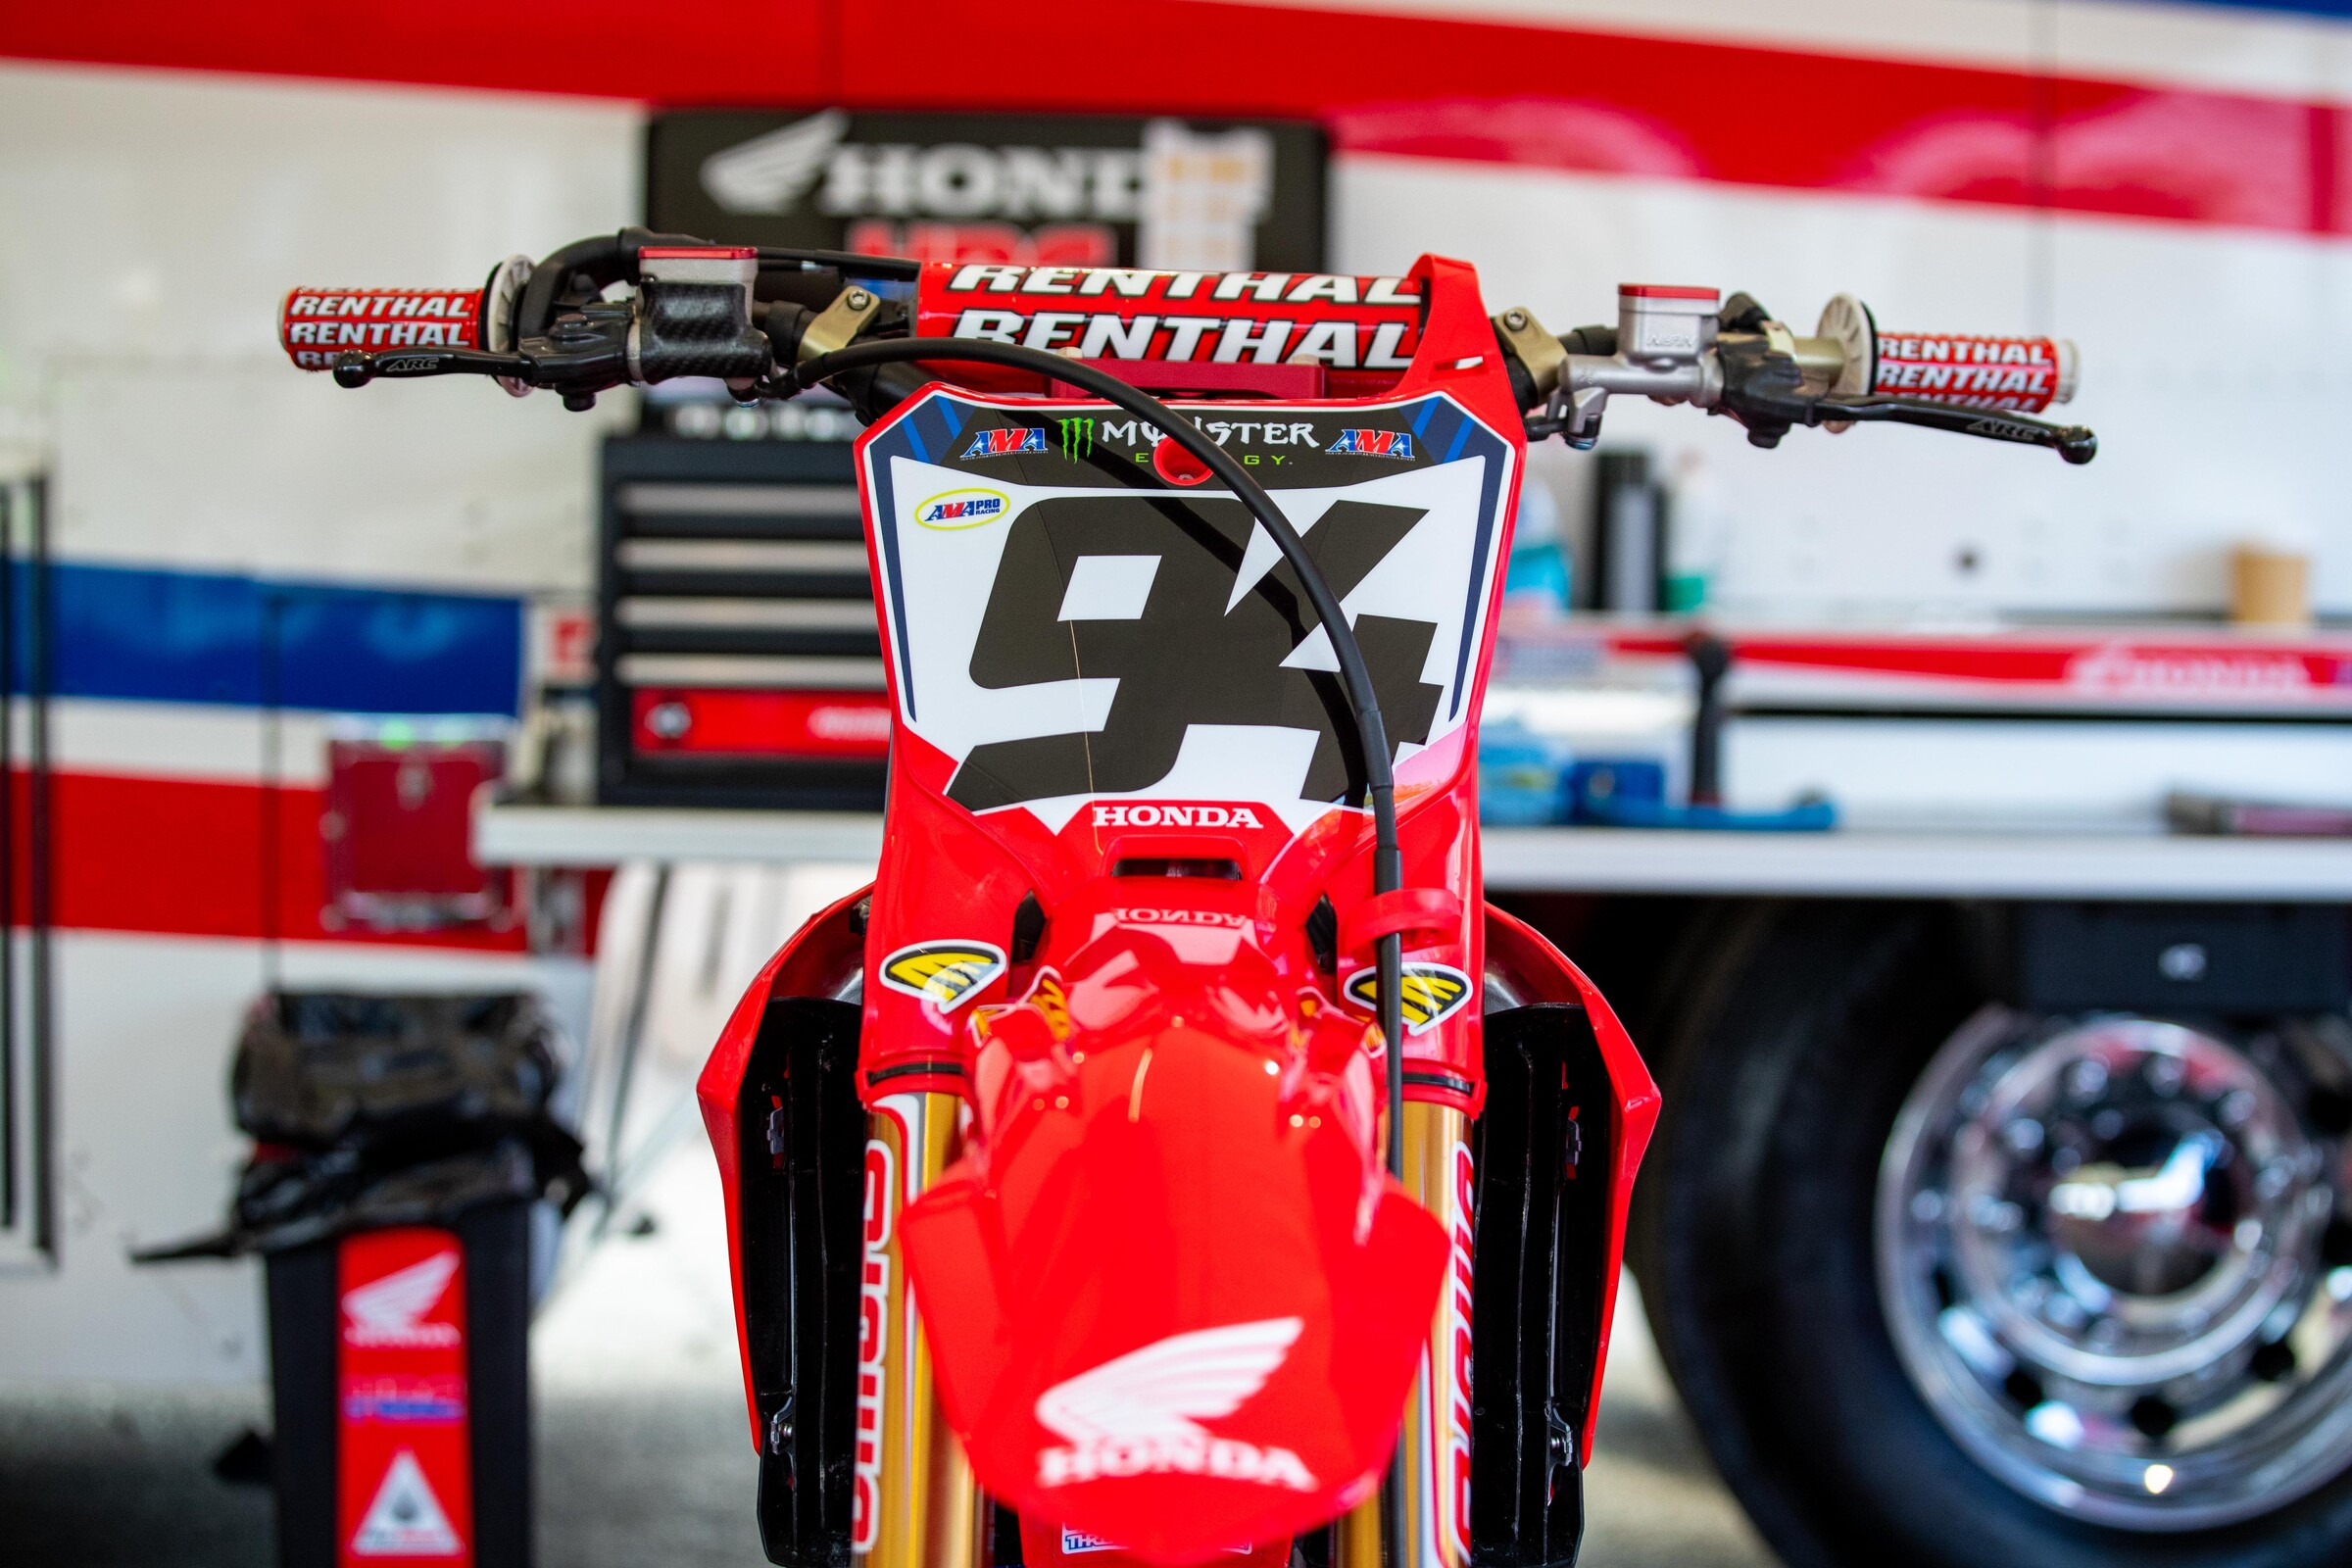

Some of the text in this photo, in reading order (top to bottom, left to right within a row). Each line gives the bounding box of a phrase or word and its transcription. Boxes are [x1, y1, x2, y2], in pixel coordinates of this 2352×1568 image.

[825, 144, 1147, 218] HOND
[950, 264, 1421, 305] RENTHAL
[290, 296, 470, 317] RENTHAL
[290, 321, 470, 345] RENTHAL
[954, 309, 1416, 368] RENTHAL
[386, 358, 439, 372] ARC
[1878, 337, 2052, 366] RENTHAL
[1876, 363, 2049, 393] RENTHAL
[959, 427, 1049, 458] AMA
[1324, 428, 1416, 459] AMA
[924, 498, 1001, 521] AMA PRO
[945, 496, 1445, 812] 94
[1093, 805, 1264, 829] HONDA
[1036, 1435, 1319, 1494] HONDA
